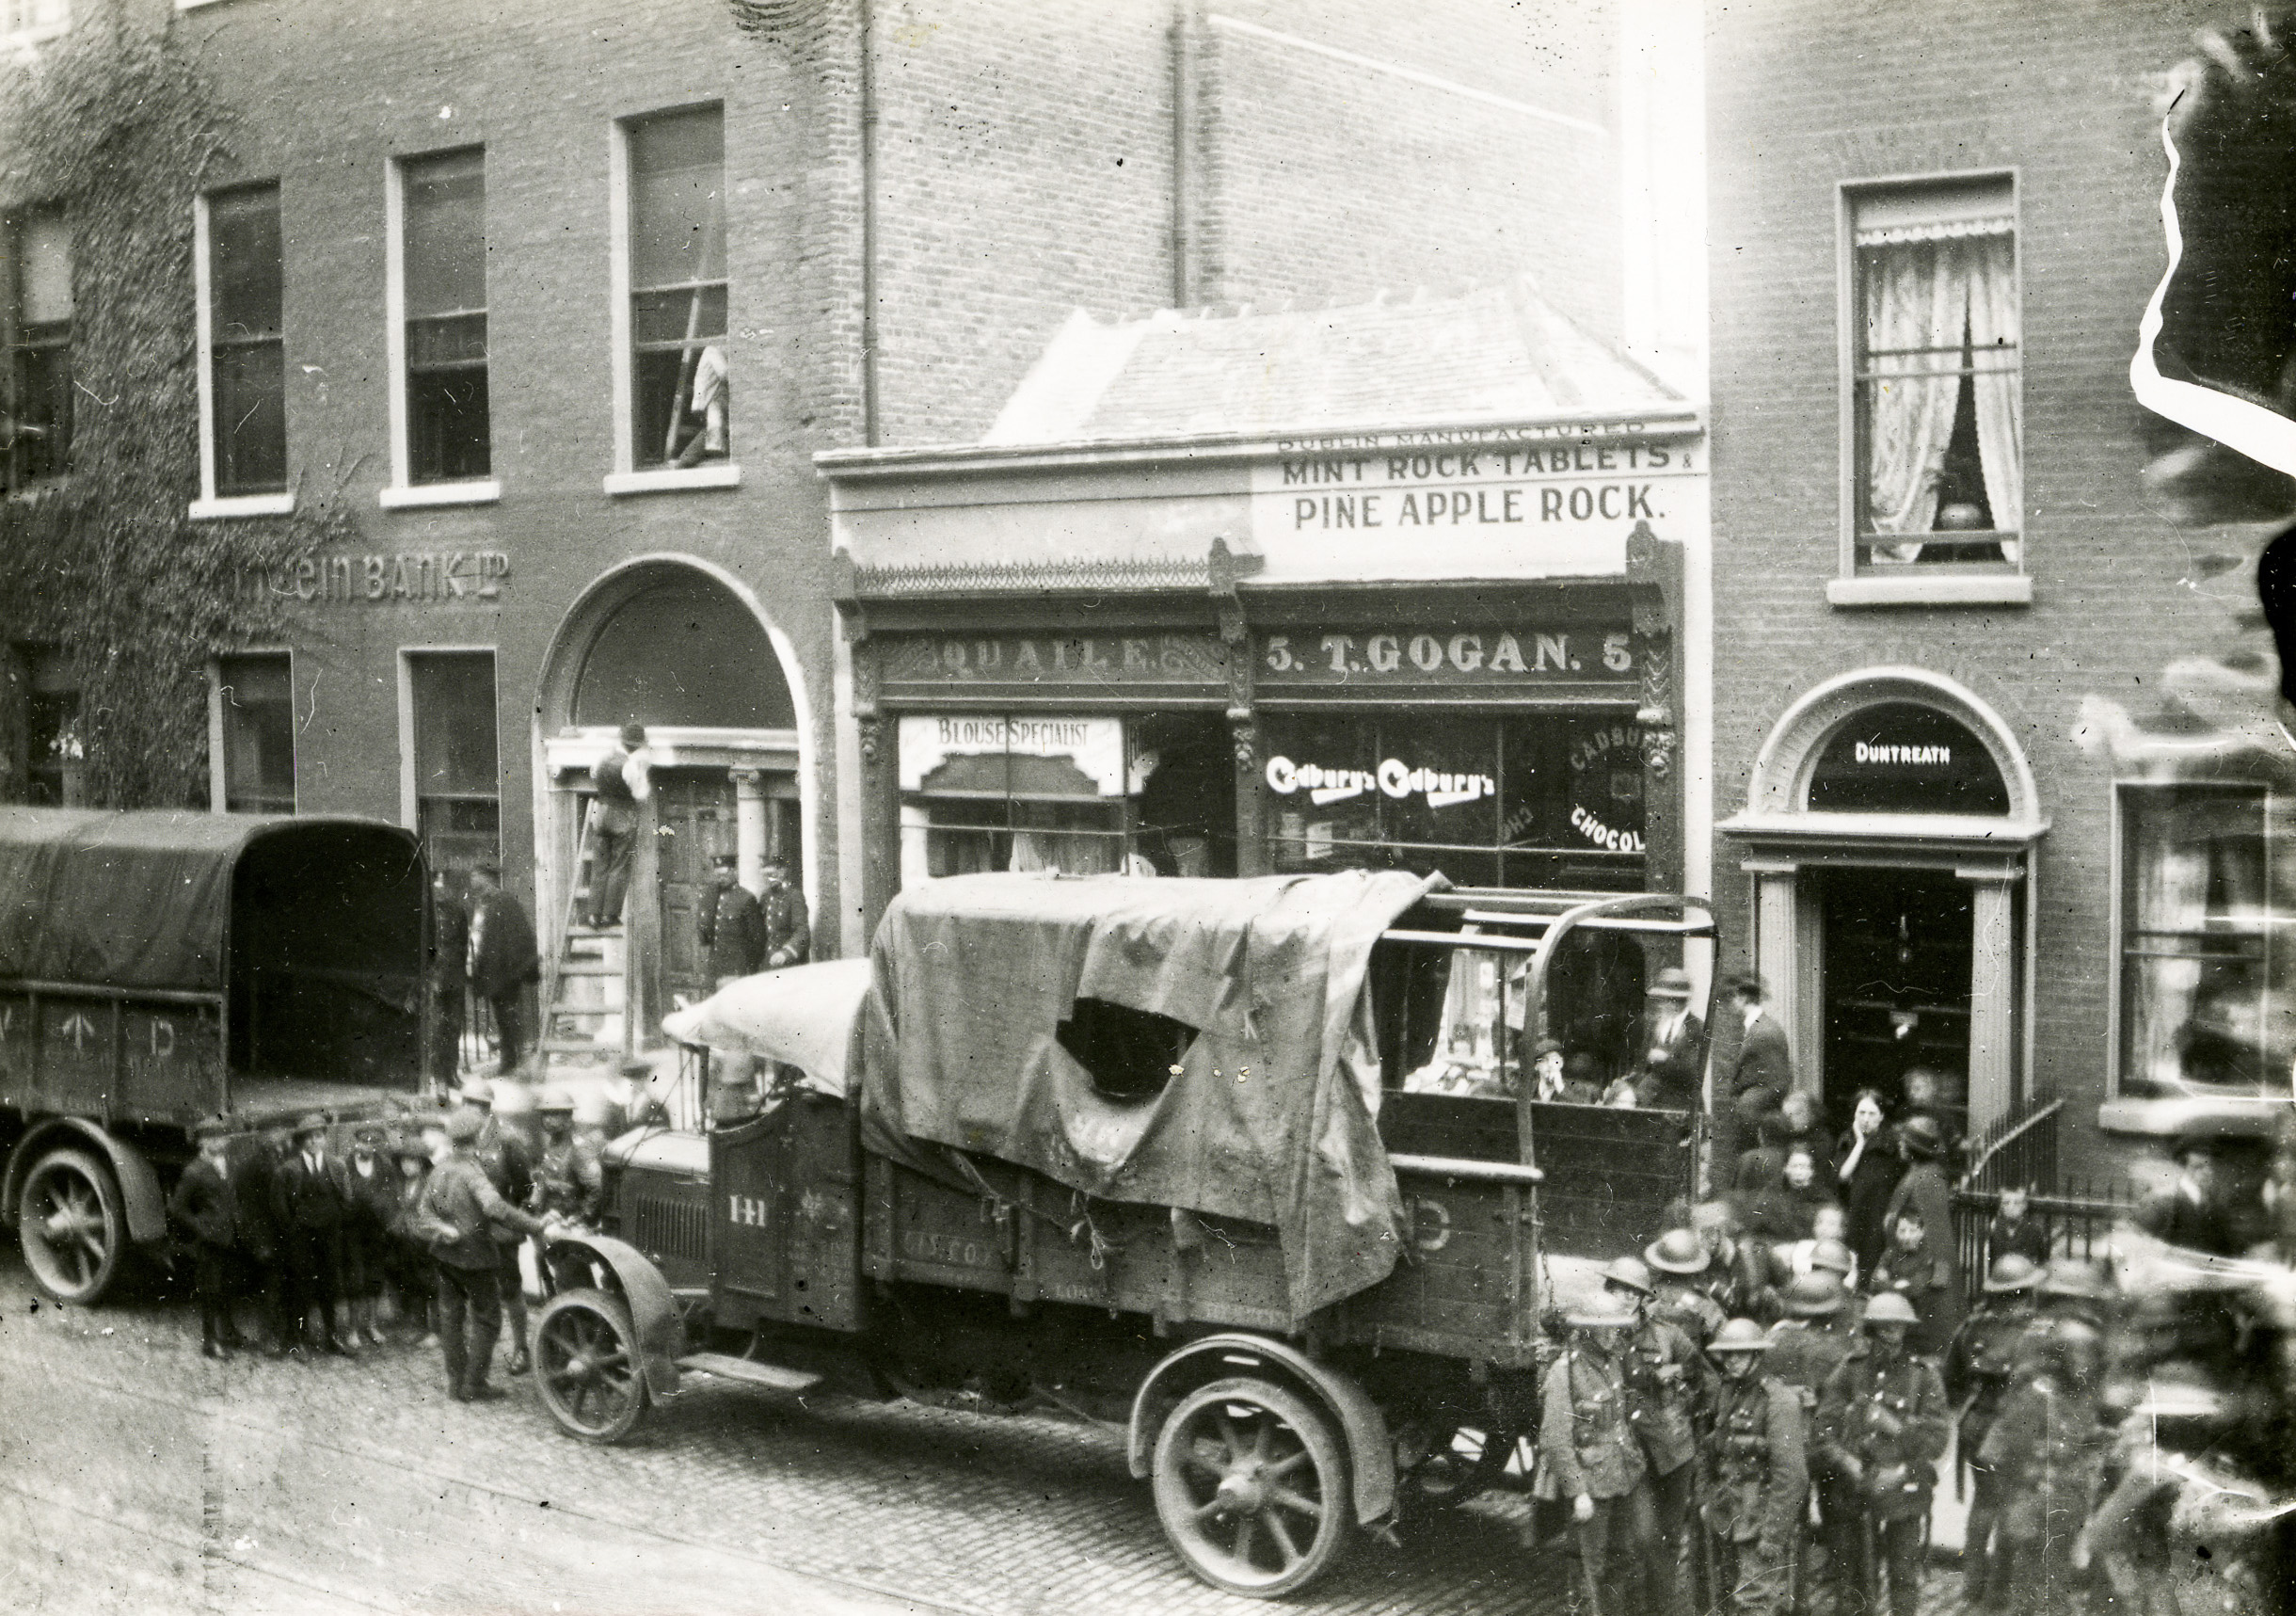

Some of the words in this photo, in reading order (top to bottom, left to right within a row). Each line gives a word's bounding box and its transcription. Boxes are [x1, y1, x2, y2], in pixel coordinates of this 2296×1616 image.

[1282, 457, 1371, 485] MINT
[1387, 452, 1481, 481] ROCK
[1503, 442, 1671, 476] TABLETS
[1295, 495, 1382, 530] PINE
[1398, 488, 1524, 526] APPLE
[1539, 483, 1666, 523] ROCK.
[1603, 632, 1633, 672] 5
[1571, 727, 1650, 771] CADBU
[1267, 756, 1376, 806] Cadbury's
[1378, 759, 1495, 808] Cadbury's
